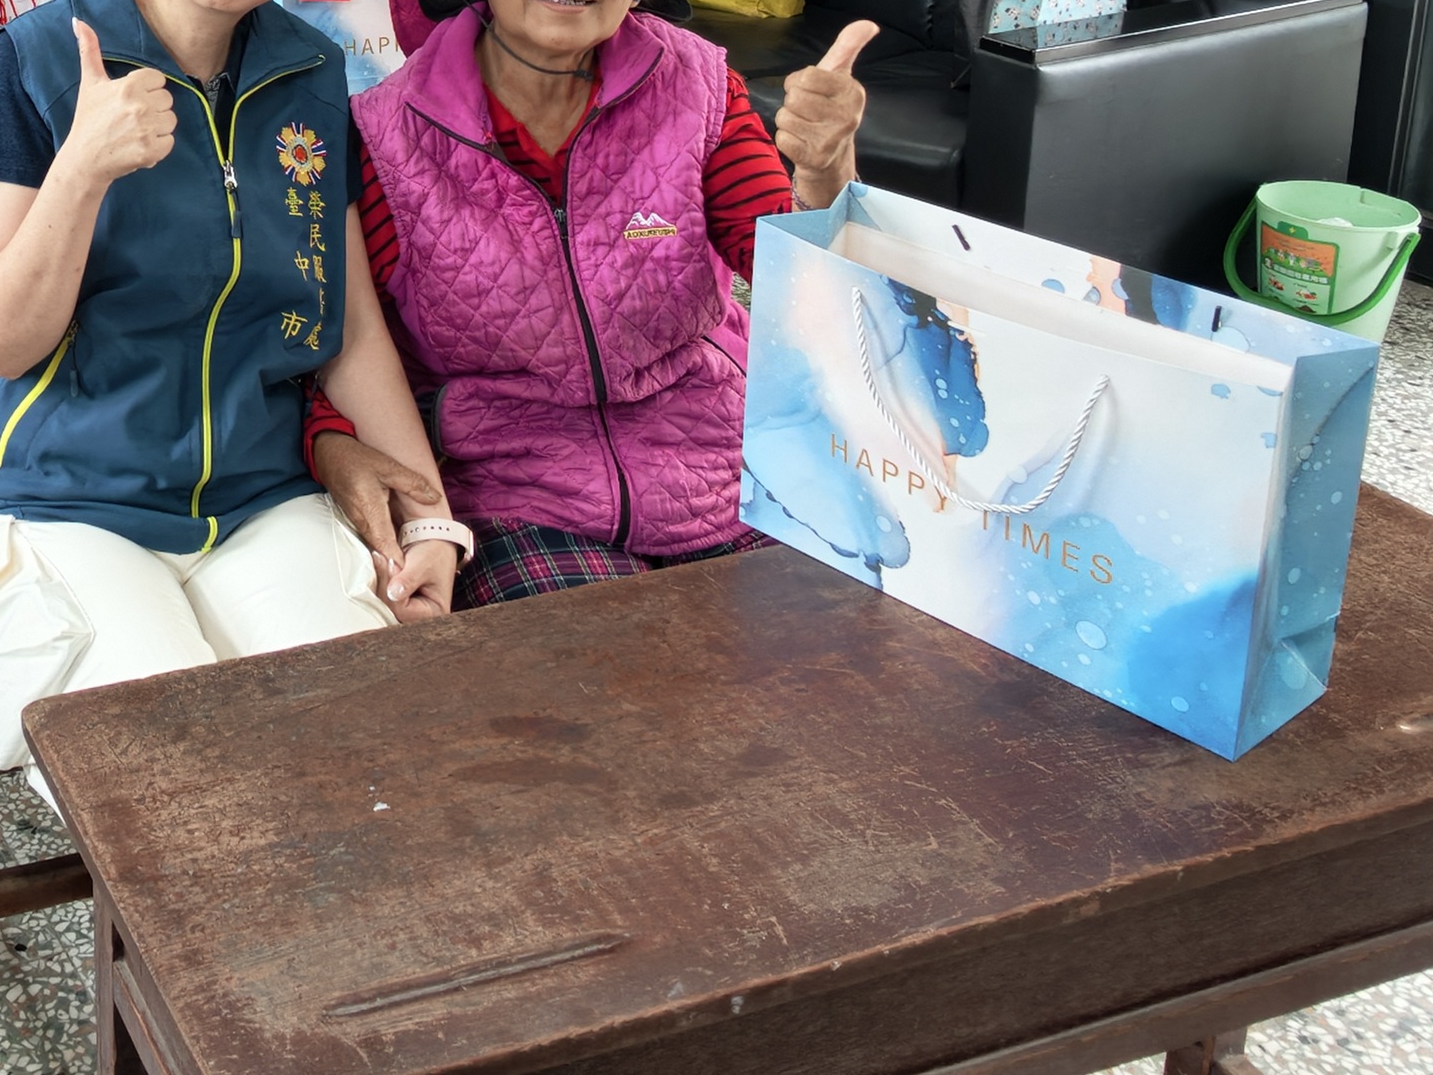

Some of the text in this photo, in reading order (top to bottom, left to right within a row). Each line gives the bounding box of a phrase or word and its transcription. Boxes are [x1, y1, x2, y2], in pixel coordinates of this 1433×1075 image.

[344, 36, 399, 57] HAP
[280, 186, 310, 340] 臺中市
[830, 432, 948, 512] HAPPY
